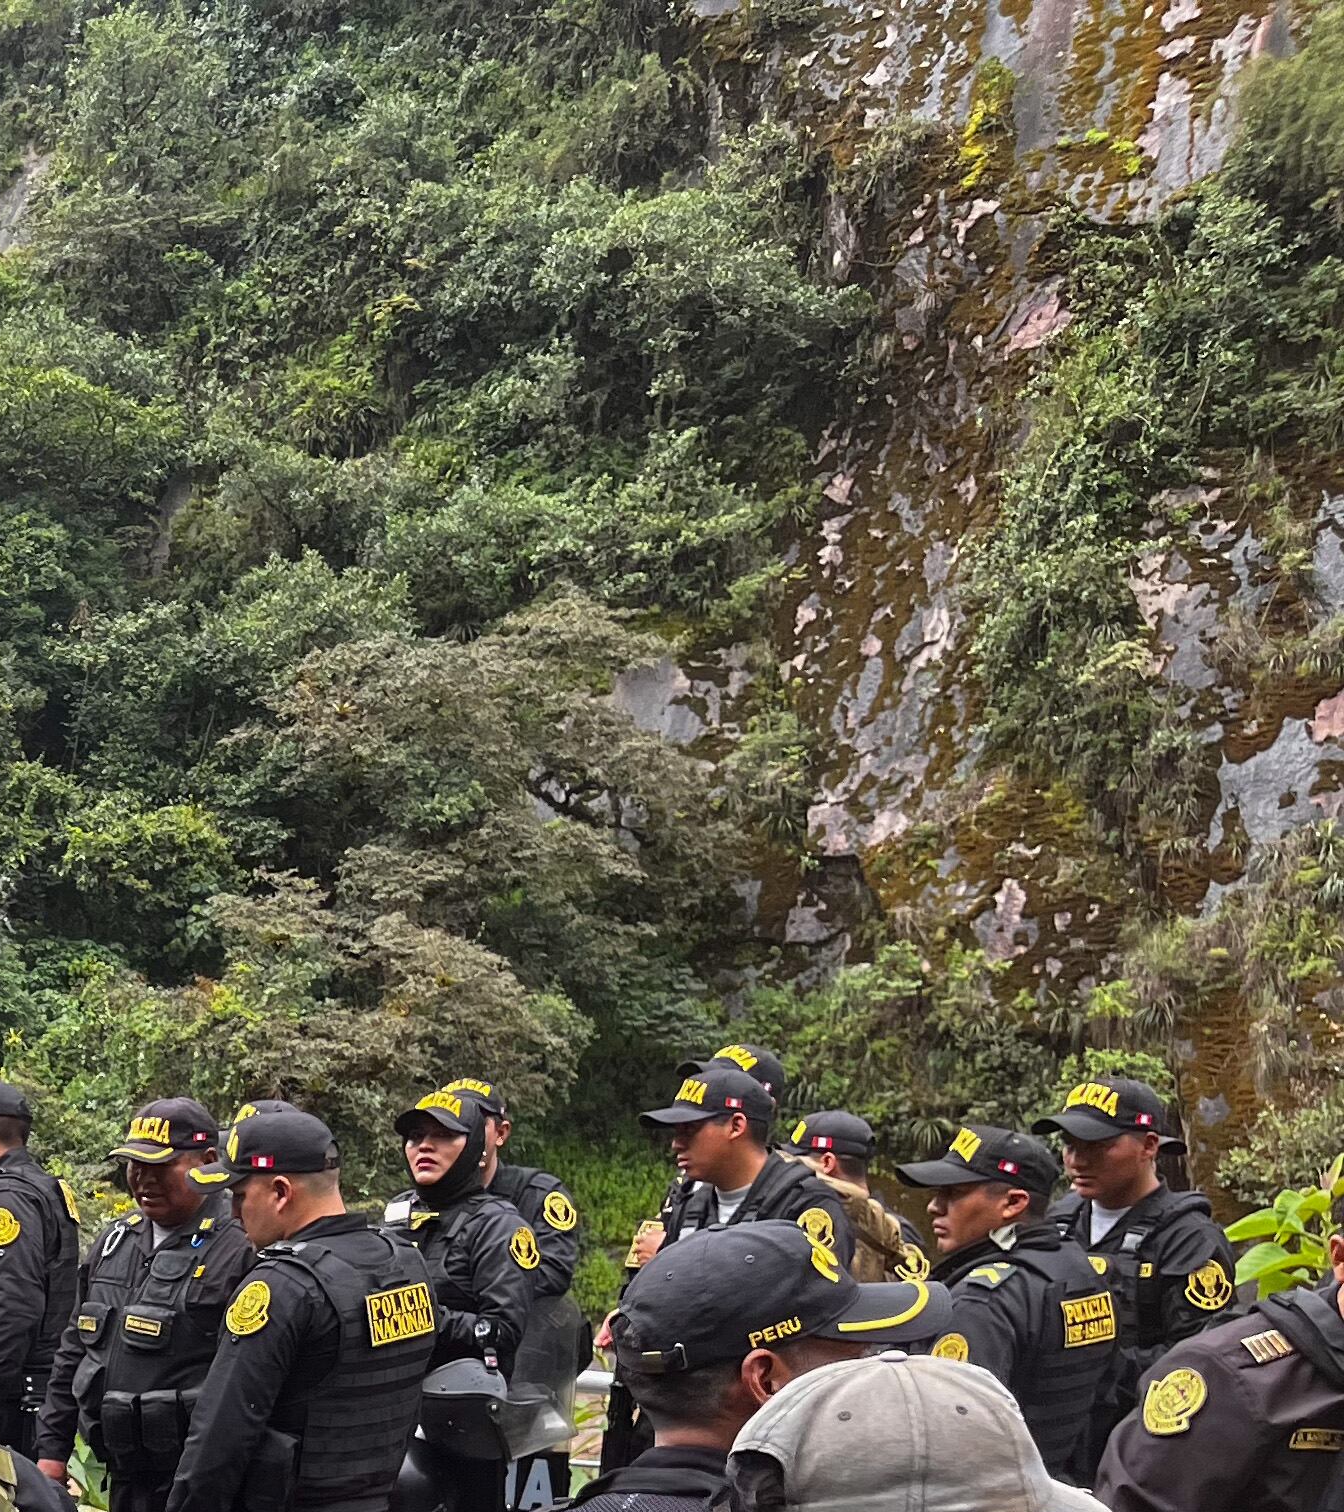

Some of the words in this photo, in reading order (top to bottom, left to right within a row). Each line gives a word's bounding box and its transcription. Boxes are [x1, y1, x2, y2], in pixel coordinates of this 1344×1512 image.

[371, 1287, 428, 1320] POLICIA
[373, 1308, 431, 1342] NACIONAL
[748, 1316, 802, 1349] PERU
